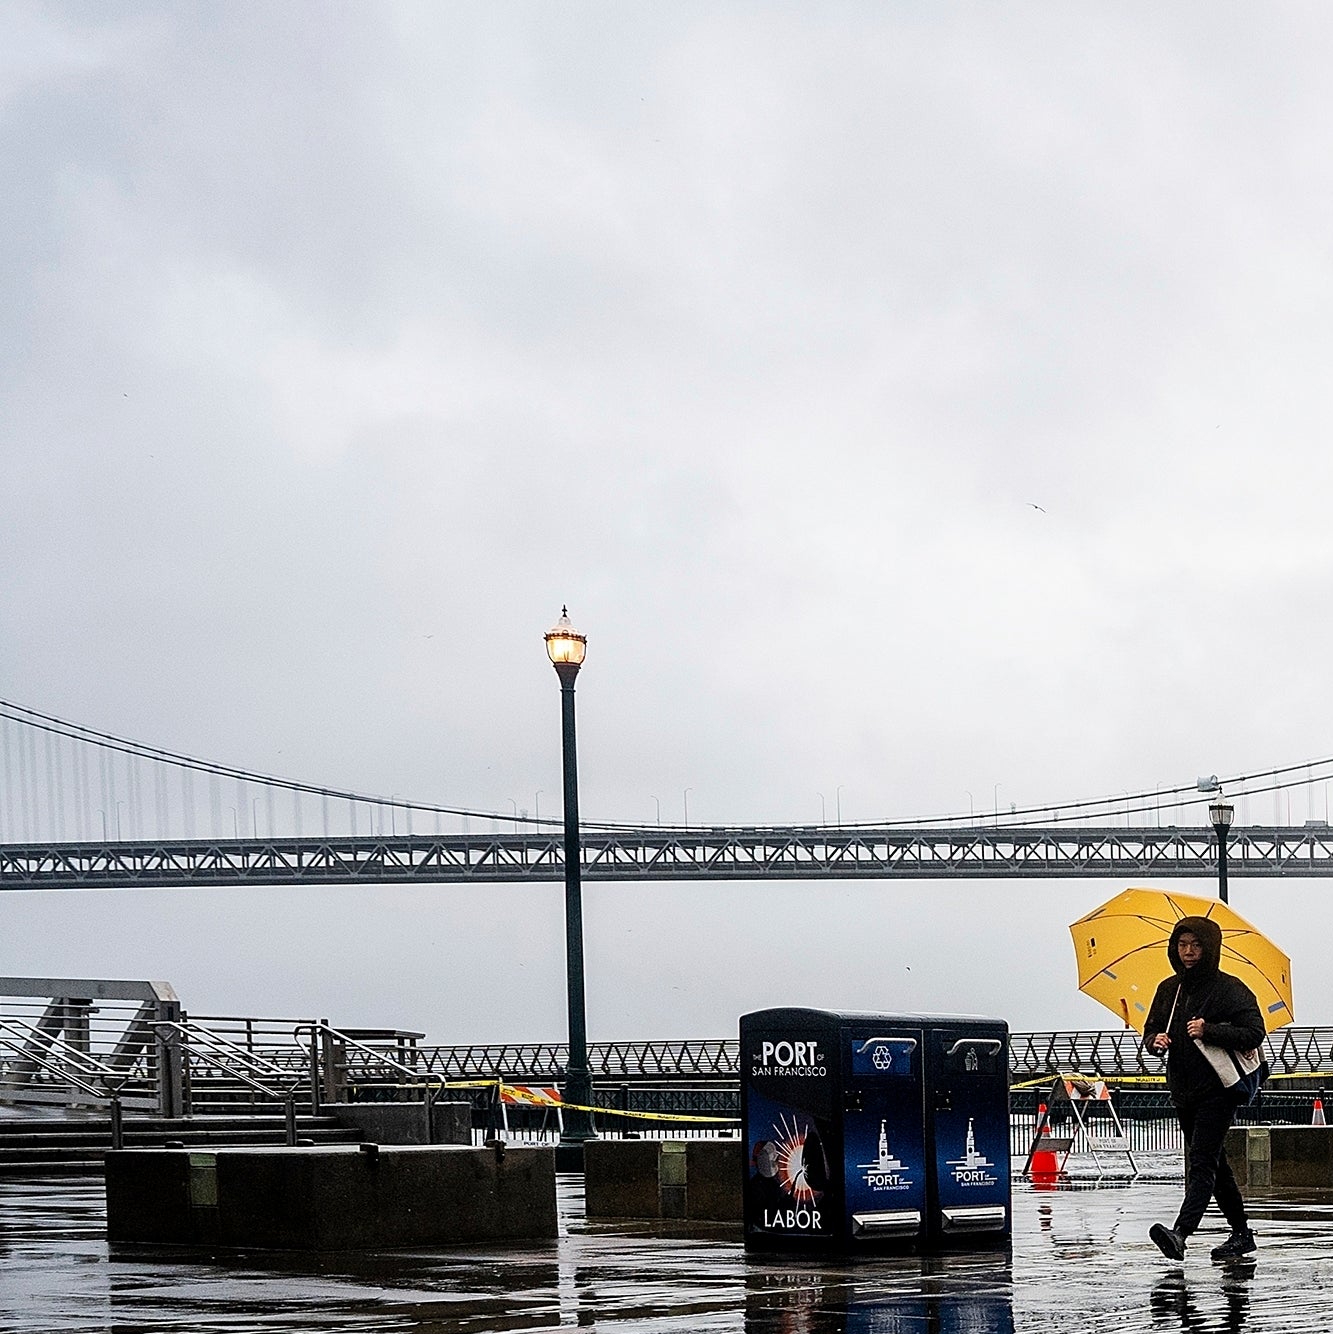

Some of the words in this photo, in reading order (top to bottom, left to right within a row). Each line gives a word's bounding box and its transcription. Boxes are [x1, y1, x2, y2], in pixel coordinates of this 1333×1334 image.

[762, 1040, 818, 1067] PORT
[752, 1066, 772, 1077] SAN
[774, 1066, 827, 1077] FRANCISCO
[867, 1174, 900, 1187] PORT
[956, 1170, 986, 1183] PORT
[764, 1208, 822, 1230] LABOR
